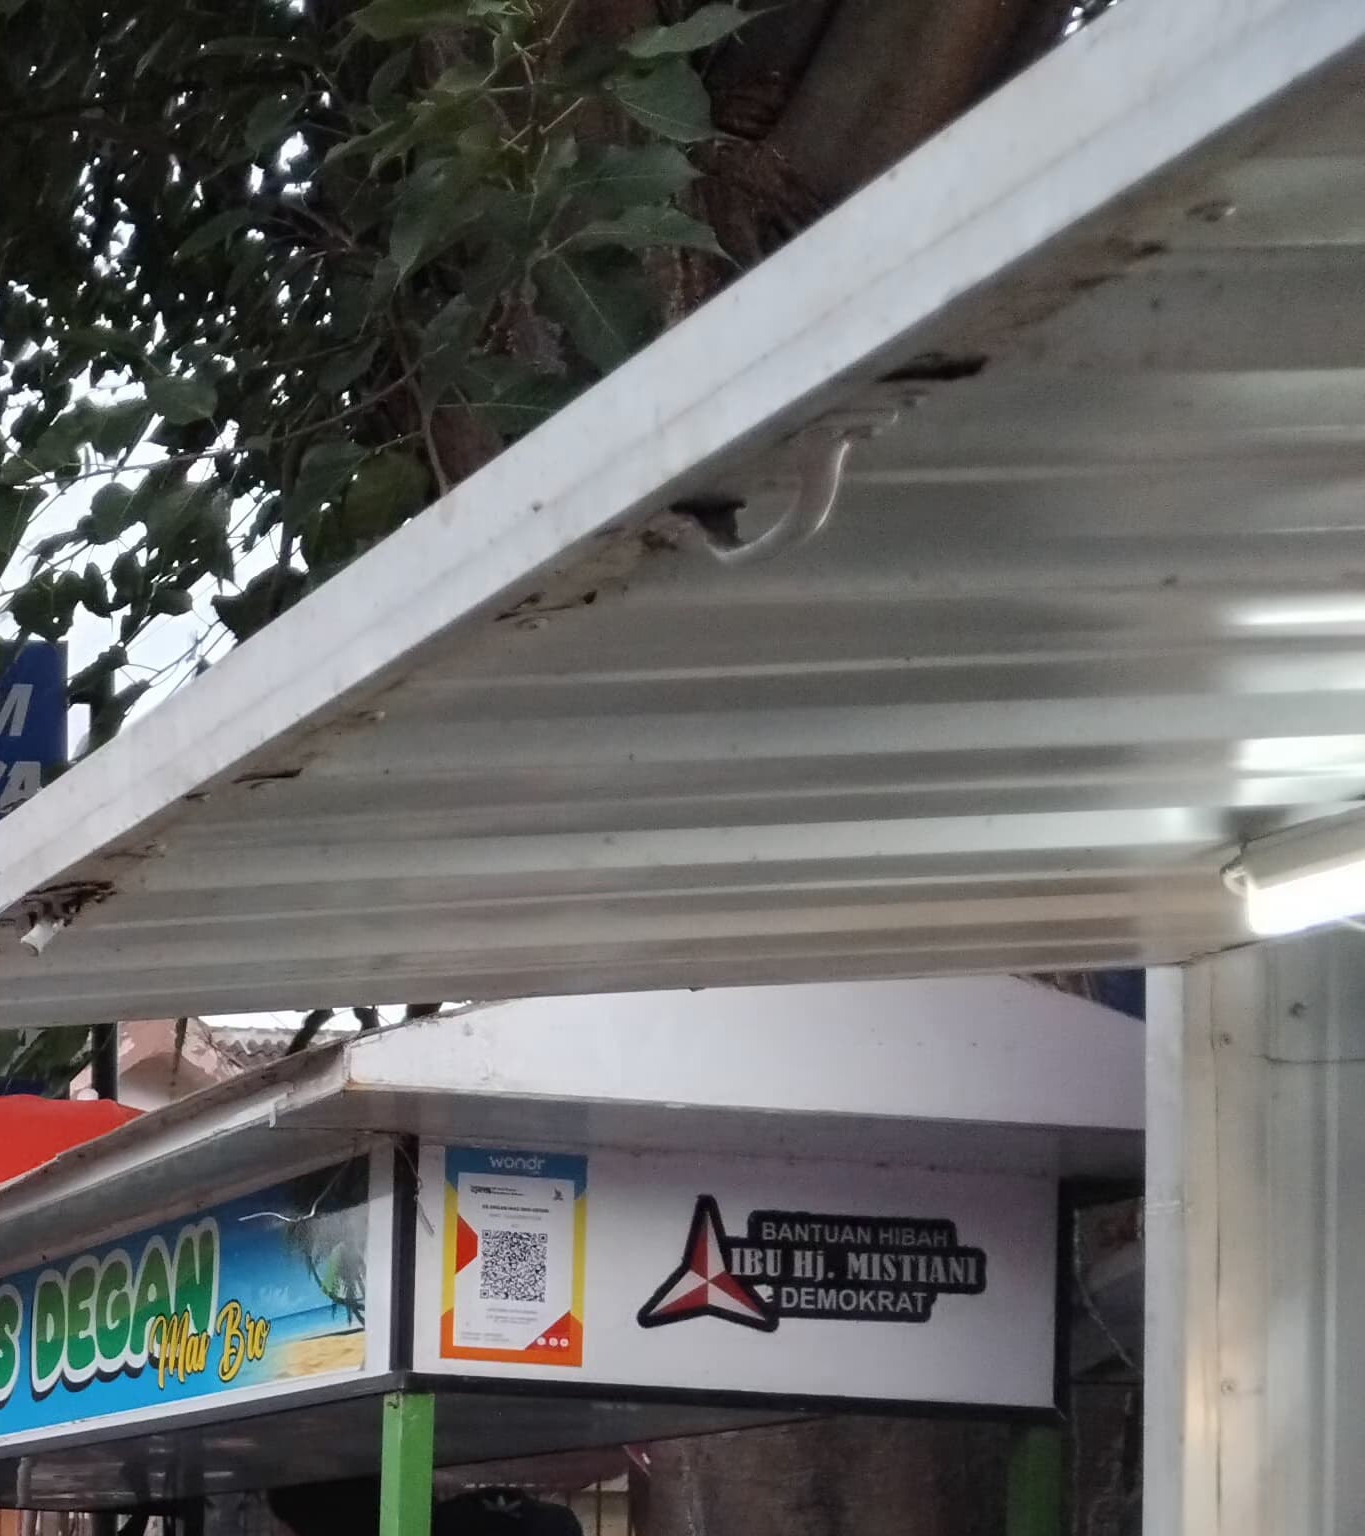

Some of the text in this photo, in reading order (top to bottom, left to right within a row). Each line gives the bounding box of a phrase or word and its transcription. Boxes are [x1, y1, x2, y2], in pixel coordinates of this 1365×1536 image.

[489, 1156, 546, 1170] wondr
[761, 1222, 949, 1247] BANTUAN HIBAH
[730, 1248, 979, 1285] IBU Hj. MISTIANI
[31, 1217, 220, 1396] DEGAN
[780, 1287, 928, 1313] DEMOKRAT
[149, 1300, 270, 1389] Mas Bro
